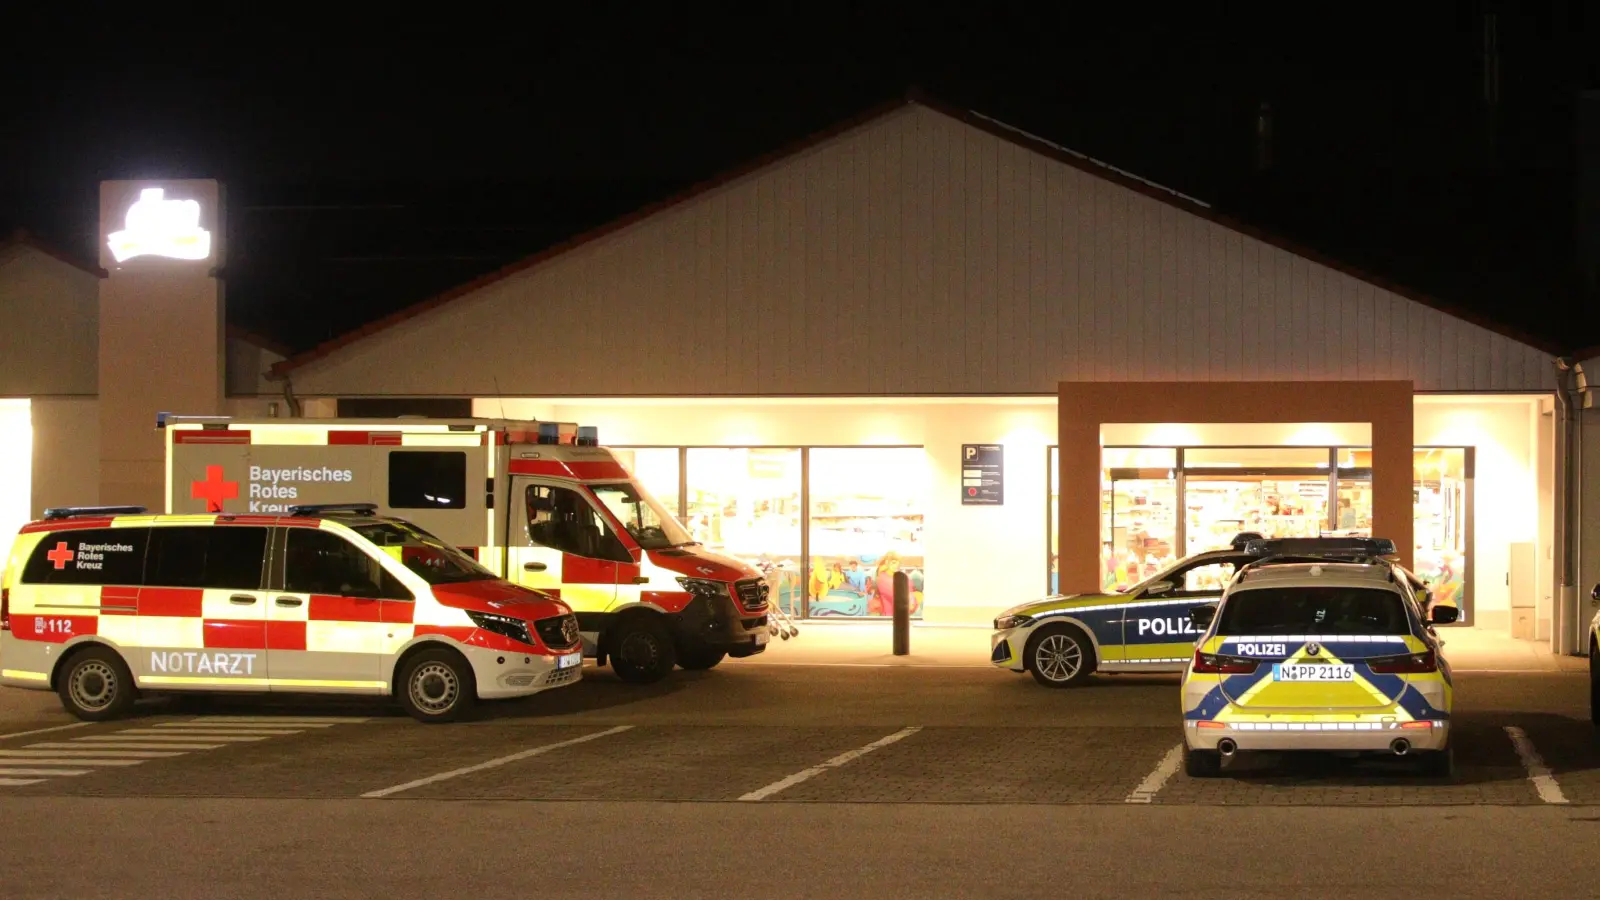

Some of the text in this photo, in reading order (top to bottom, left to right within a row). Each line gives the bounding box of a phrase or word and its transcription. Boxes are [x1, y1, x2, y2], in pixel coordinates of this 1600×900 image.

[966, 447, 977, 460] P
[249, 465, 353, 484] Bayerisches
[249, 483, 297, 499] Rotes
[79, 542, 133, 553] Bayerisches
[77, 551, 104, 561] Rotes
[76, 560, 103, 570] Kreuz
[48, 619, 72, 633] 112
[1138, 617, 1207, 636] POLIZ
[1237, 643, 1286, 656] POLIZEI
[151, 651, 257, 675] NOTARZT
[1319, 666, 1352, 679] 2116
